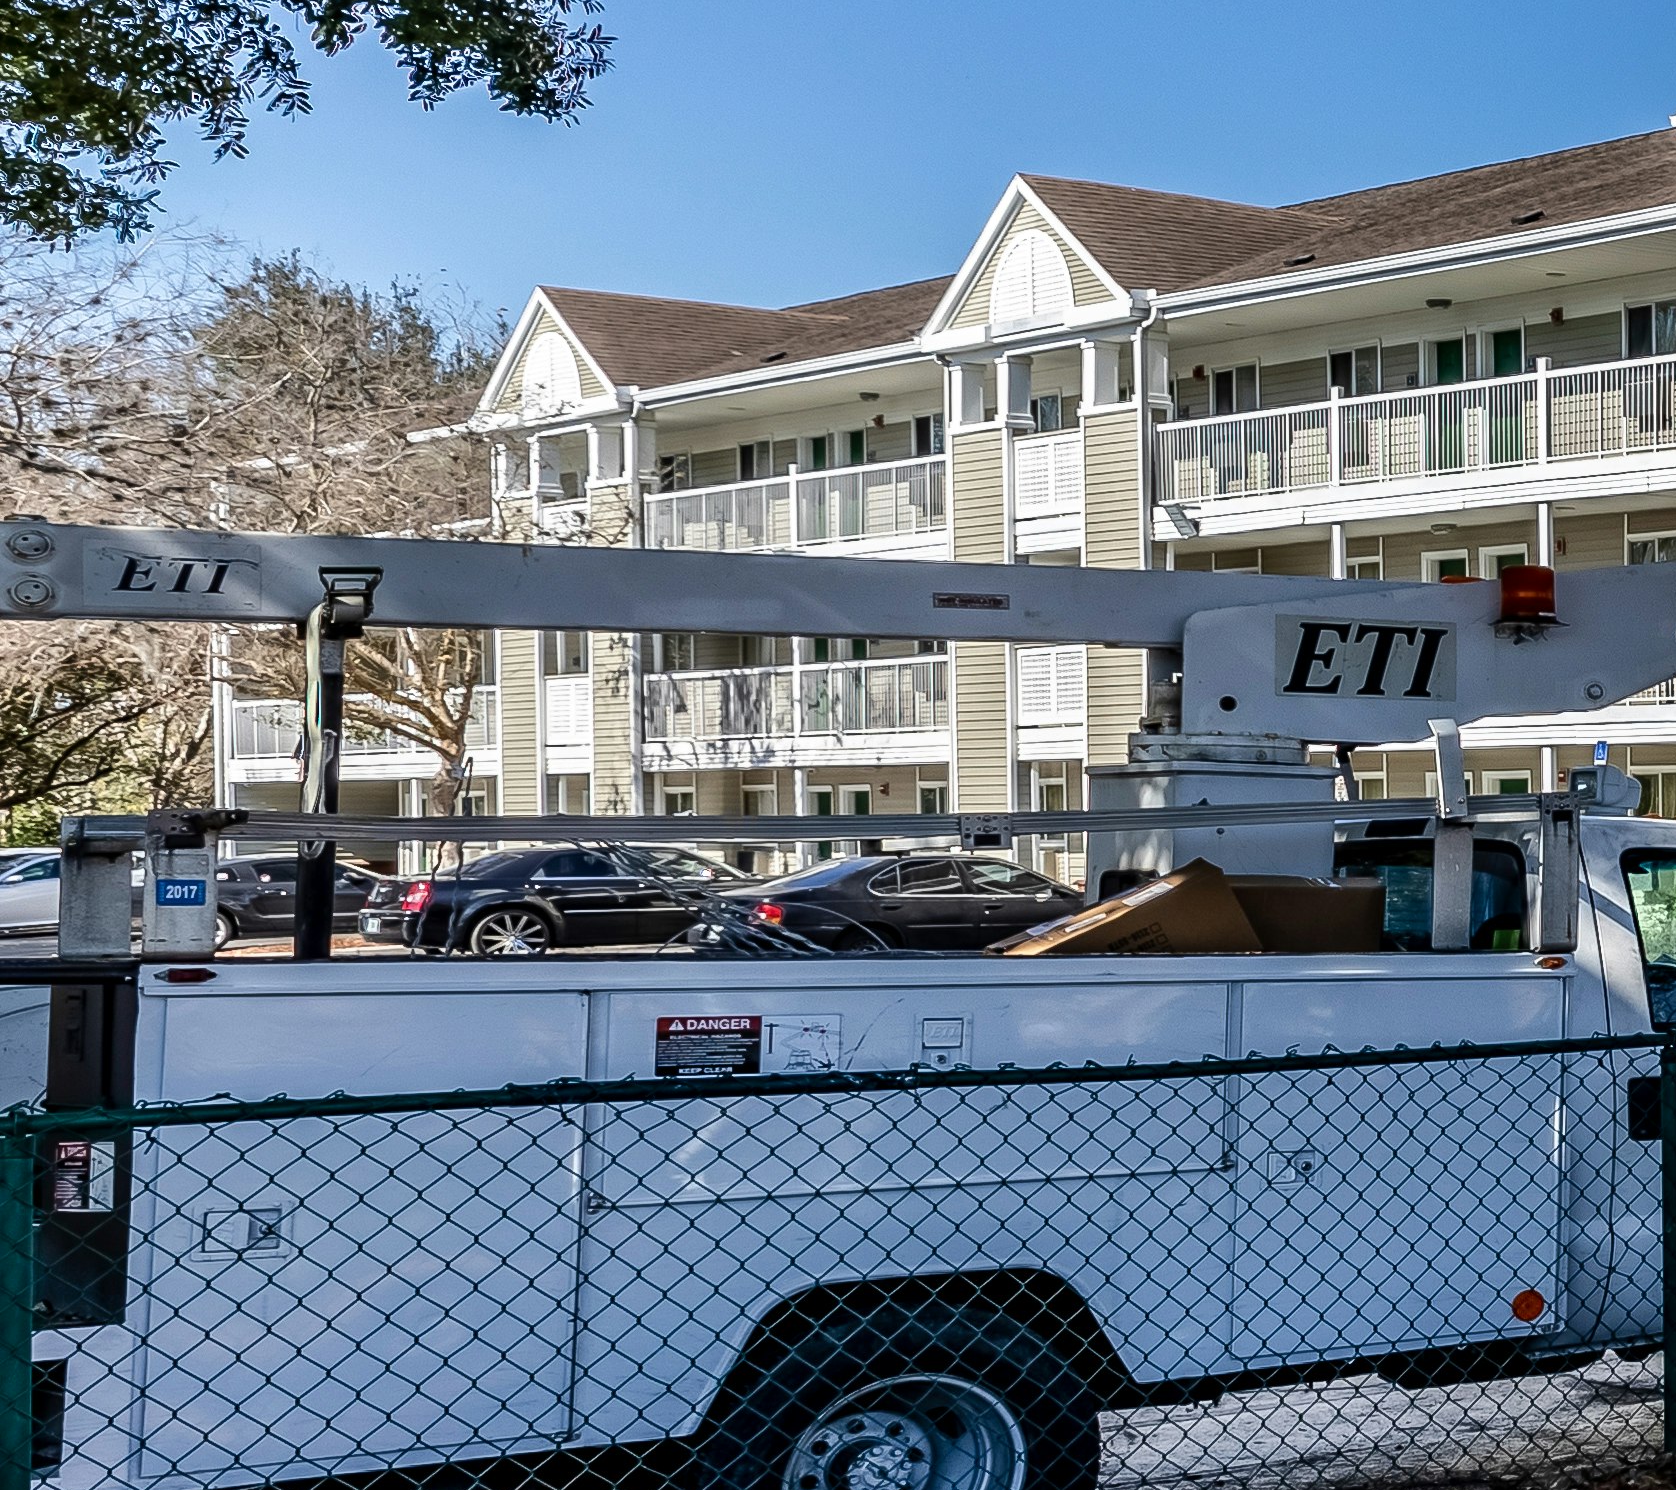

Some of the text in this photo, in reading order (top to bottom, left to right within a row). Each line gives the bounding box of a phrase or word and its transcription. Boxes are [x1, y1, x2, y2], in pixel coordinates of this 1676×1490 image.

[112, 555, 229, 595] ETI
[1282, 620, 1449, 699] ETI
[166, 886, 197, 899] 2017
[687, 1019, 750, 1030] DANGER
